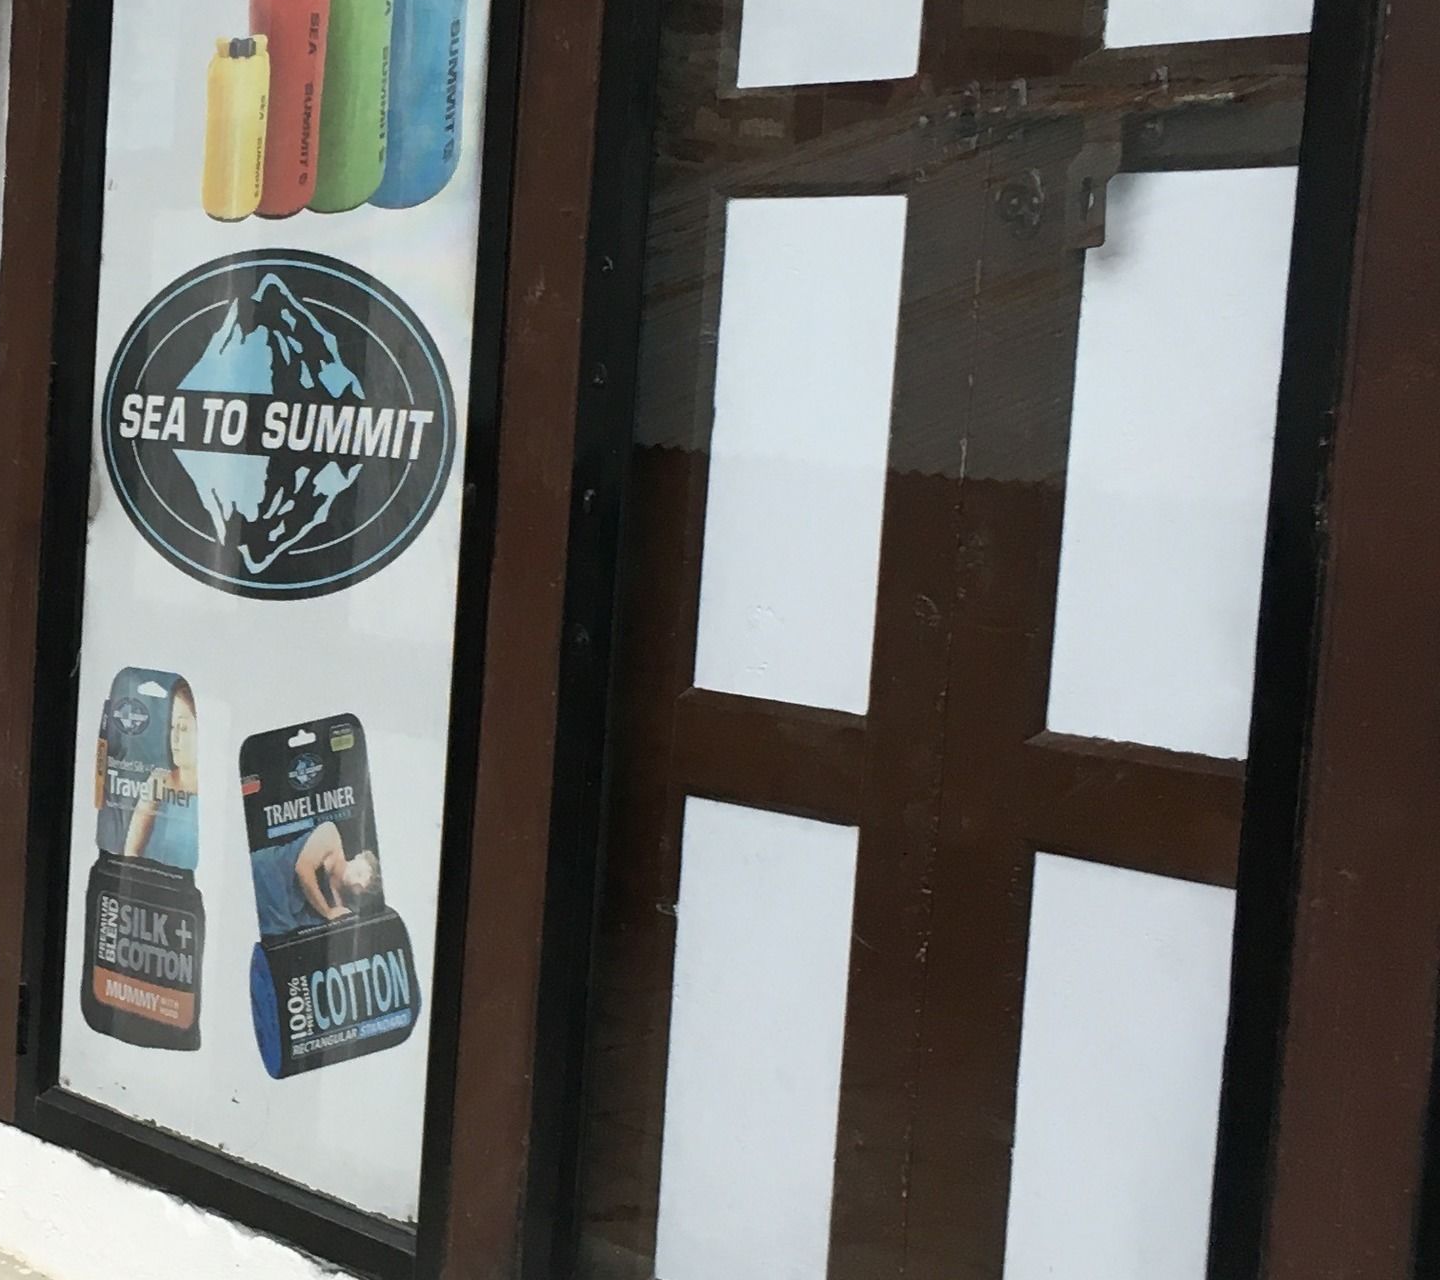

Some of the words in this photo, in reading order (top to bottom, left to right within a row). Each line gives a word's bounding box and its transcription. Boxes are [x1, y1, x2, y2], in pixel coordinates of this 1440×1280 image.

[308, 12, 320, 55] SEA
[300, 82, 314, 167] SUMMIT
[119, 393, 186, 442] SEA
[202, 398, 248, 447] TO
[261, 401, 434, 461] SUMMIT
[263, 796, 316, 827] TRAVEL
[315, 786, 356, 813] LINER
[98, 895, 110, 960] PREMIUM
[104, 898, 120, 964] BLEND
[119, 904, 168, 947] SILK
[116, 937, 193, 985] COTTON
[105, 979, 160, 1013] MUMMY
[287, 977, 309, 1041] 100%
[311, 948, 410, 1031] COTTON
[293, 1028, 358, 1057] RECTANGULAR
